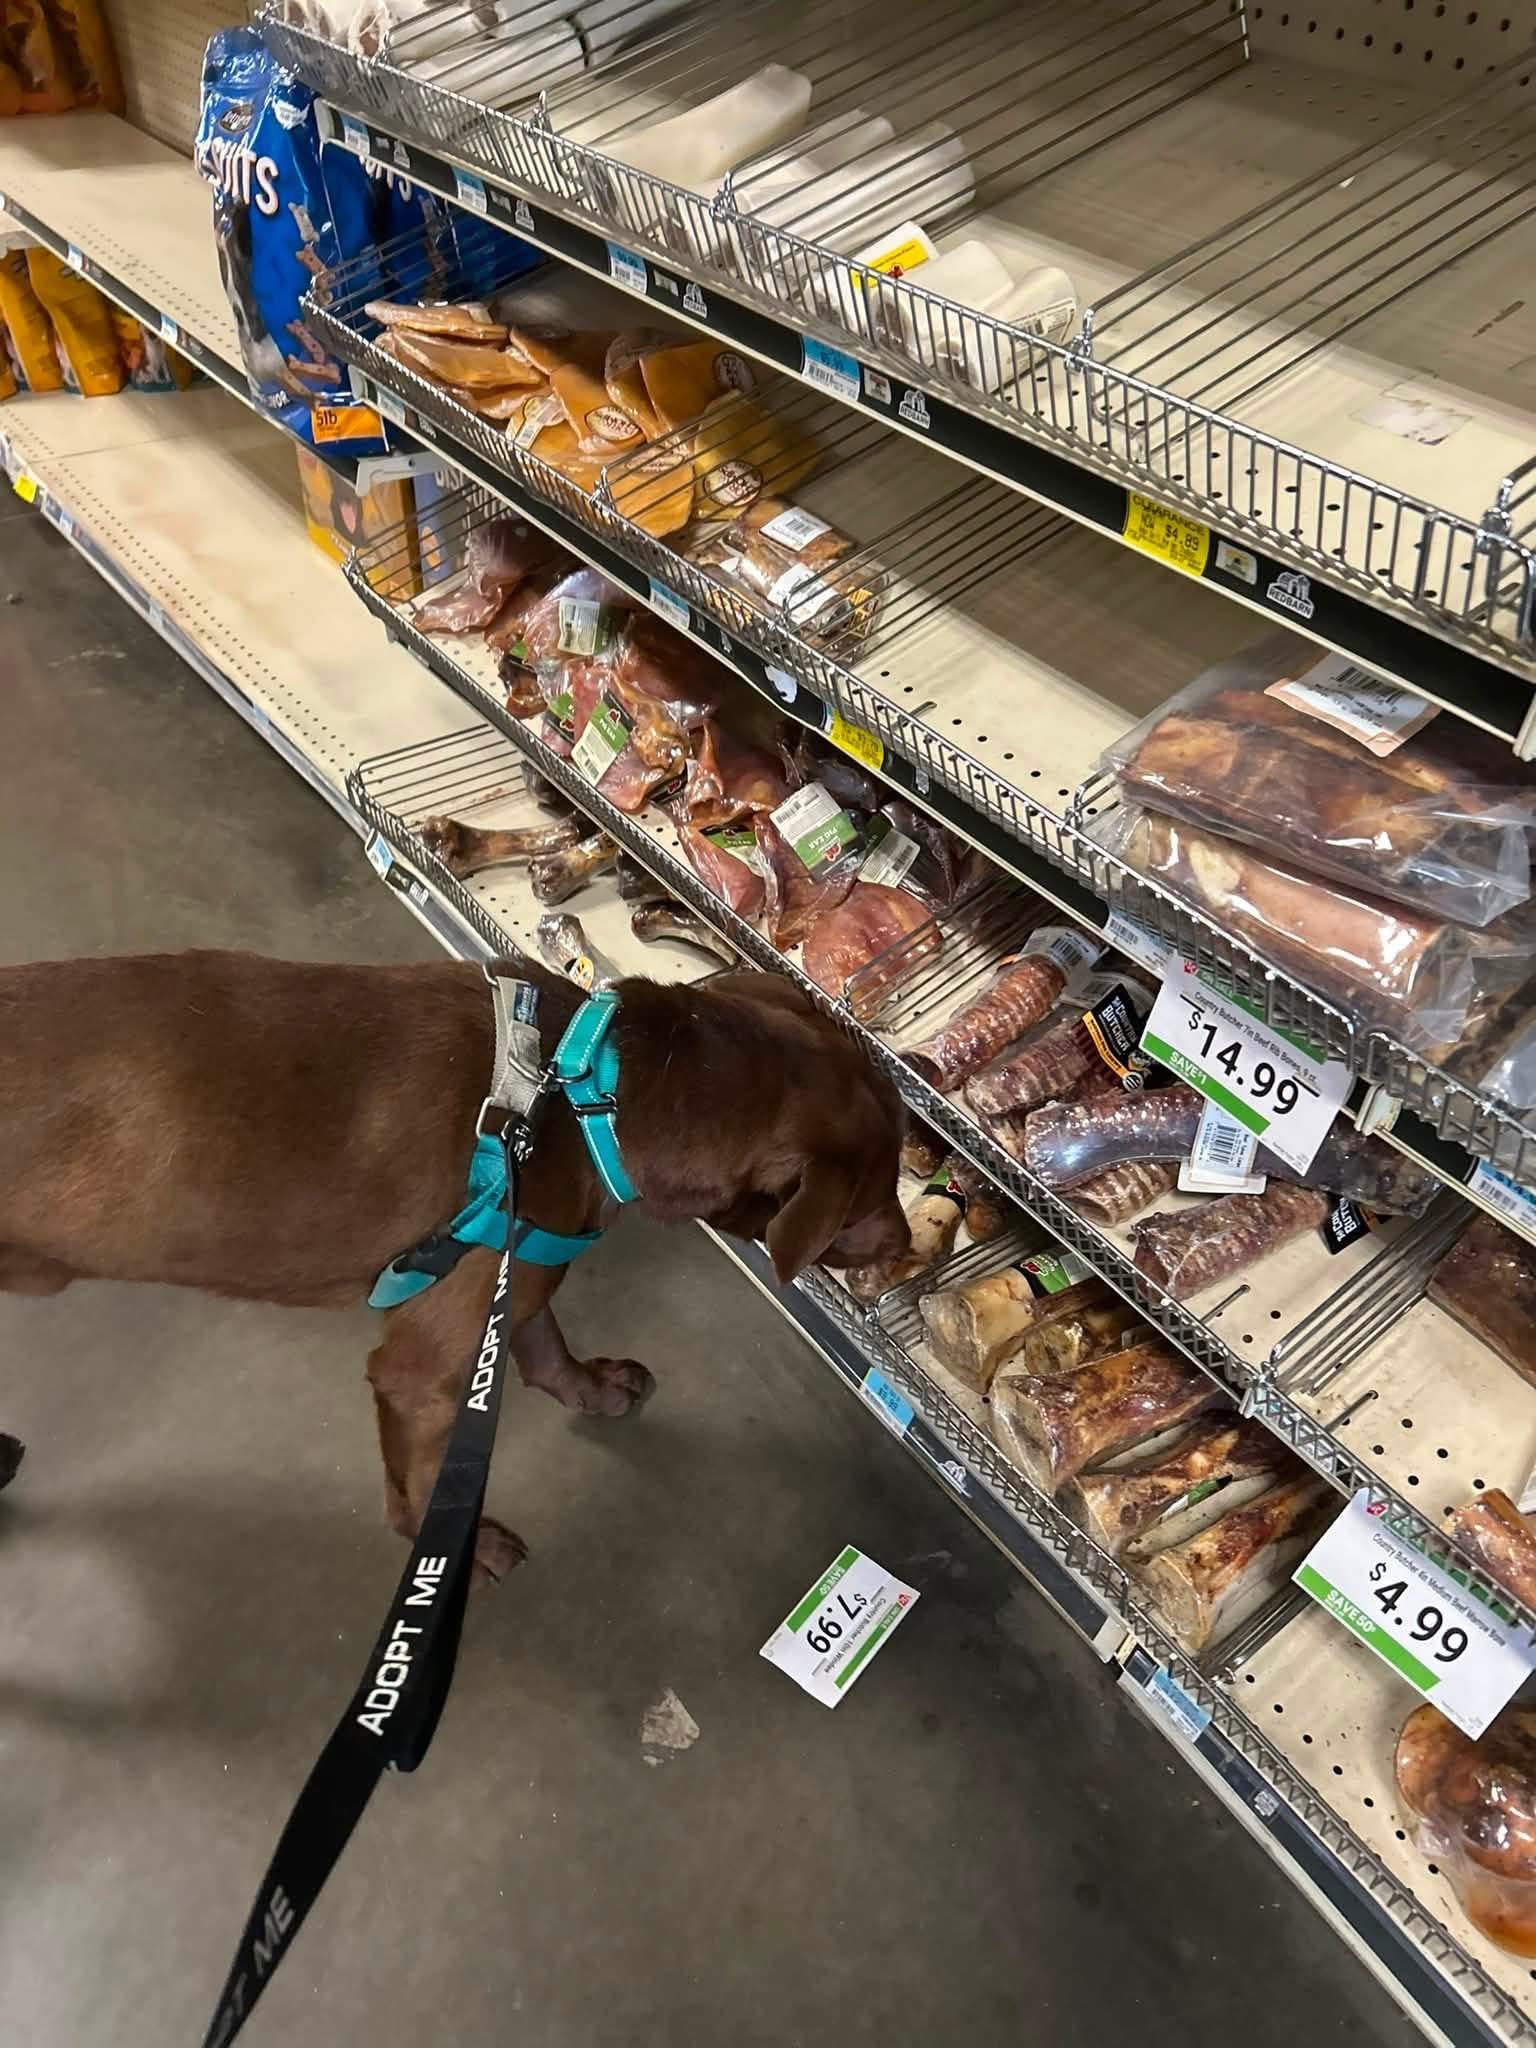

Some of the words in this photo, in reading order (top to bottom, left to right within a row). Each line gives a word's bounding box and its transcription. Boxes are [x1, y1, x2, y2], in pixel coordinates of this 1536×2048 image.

[316, 410, 337, 426] 5lb
[1132, 494, 1205, 533] CLEARANCE
[1268, 584, 1312, 616] REDBARN
[807, 836, 825, 849] EAR
[1101, 1004, 1131, 1052] BUTCHER
[1195, 991, 1218, 1015] Country
[1218, 1004, 1246, 1030] Butcher
[1254, 1033, 1270, 1049] Beef
[1270, 1043, 1281, 1057] Rib
[1188, 1011, 1299, 1115] $14.99
[467, 1313, 504, 1411] ADOPT
[1369, 1561, 1469, 1663] $4.99
[1372, 1533, 1396, 1556] Country
[1394, 1551, 1419, 1575] Butcher
[1427, 1577, 1453, 1603] Medium
[1452, 1598, 1469, 1616] Beef
[1467, 1611, 1492, 1634] Marrow
[357, 1619, 424, 1736] ADOPT
[404, 1556, 448, 1606] ME
[806, 1592, 869, 1655] $7.99
[853, 1616, 872, 1642] Butcher
[253, 1885, 295, 1977] ME
